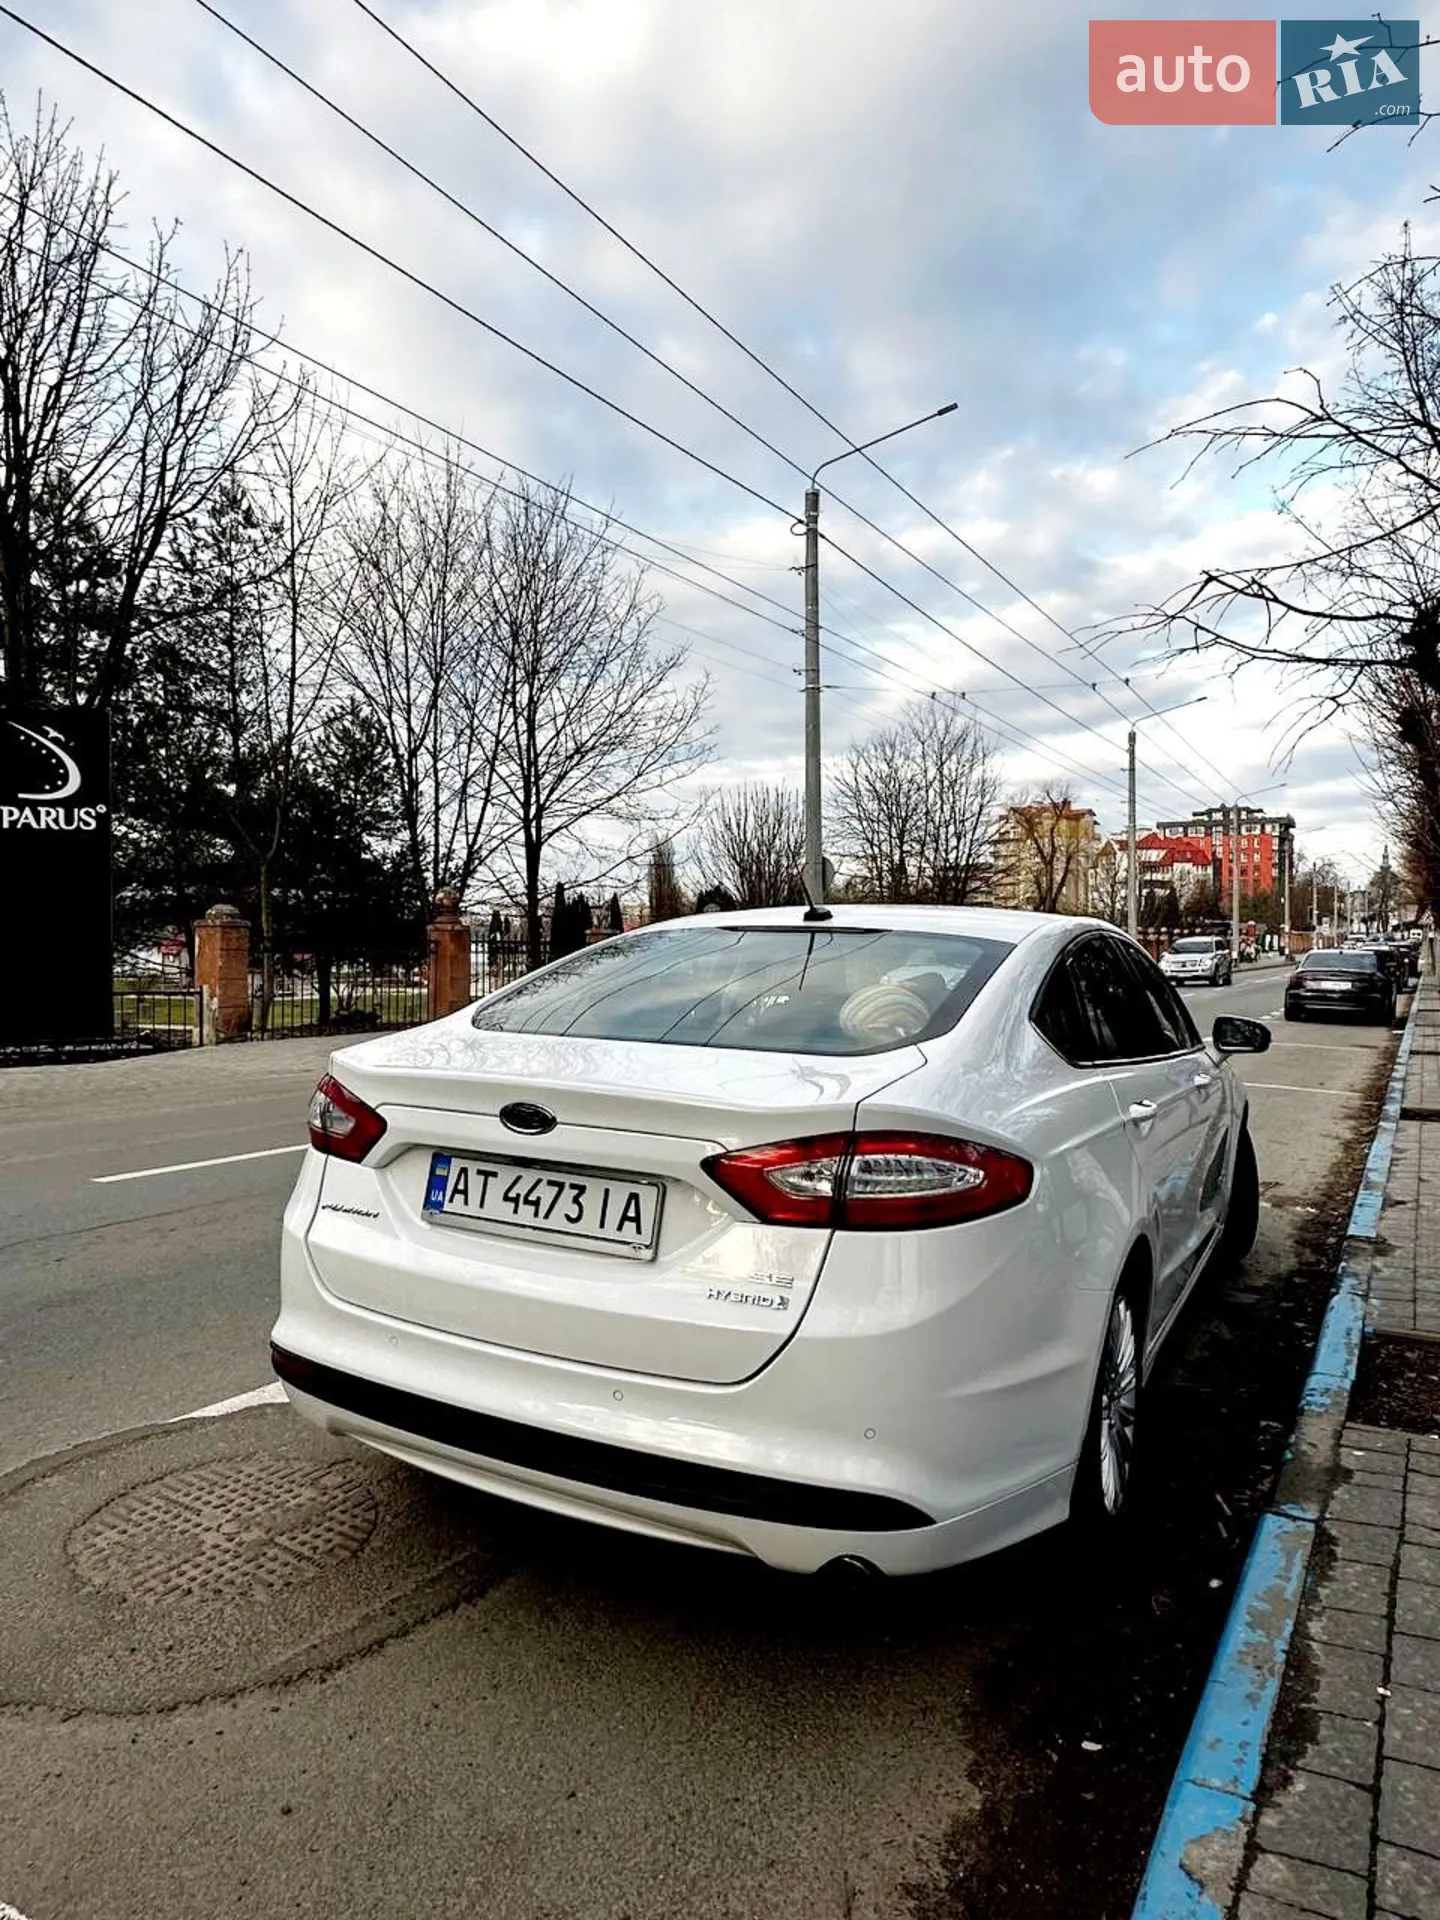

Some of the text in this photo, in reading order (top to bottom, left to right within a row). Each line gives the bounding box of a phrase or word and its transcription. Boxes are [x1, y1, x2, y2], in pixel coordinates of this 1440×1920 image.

[0, 805, 97, 831] PARUS
[430, 1188, 444, 1203] UA
[448, 1166, 643, 1236] AT 4473 IA
[707, 1287, 774, 1307] HYBRID
